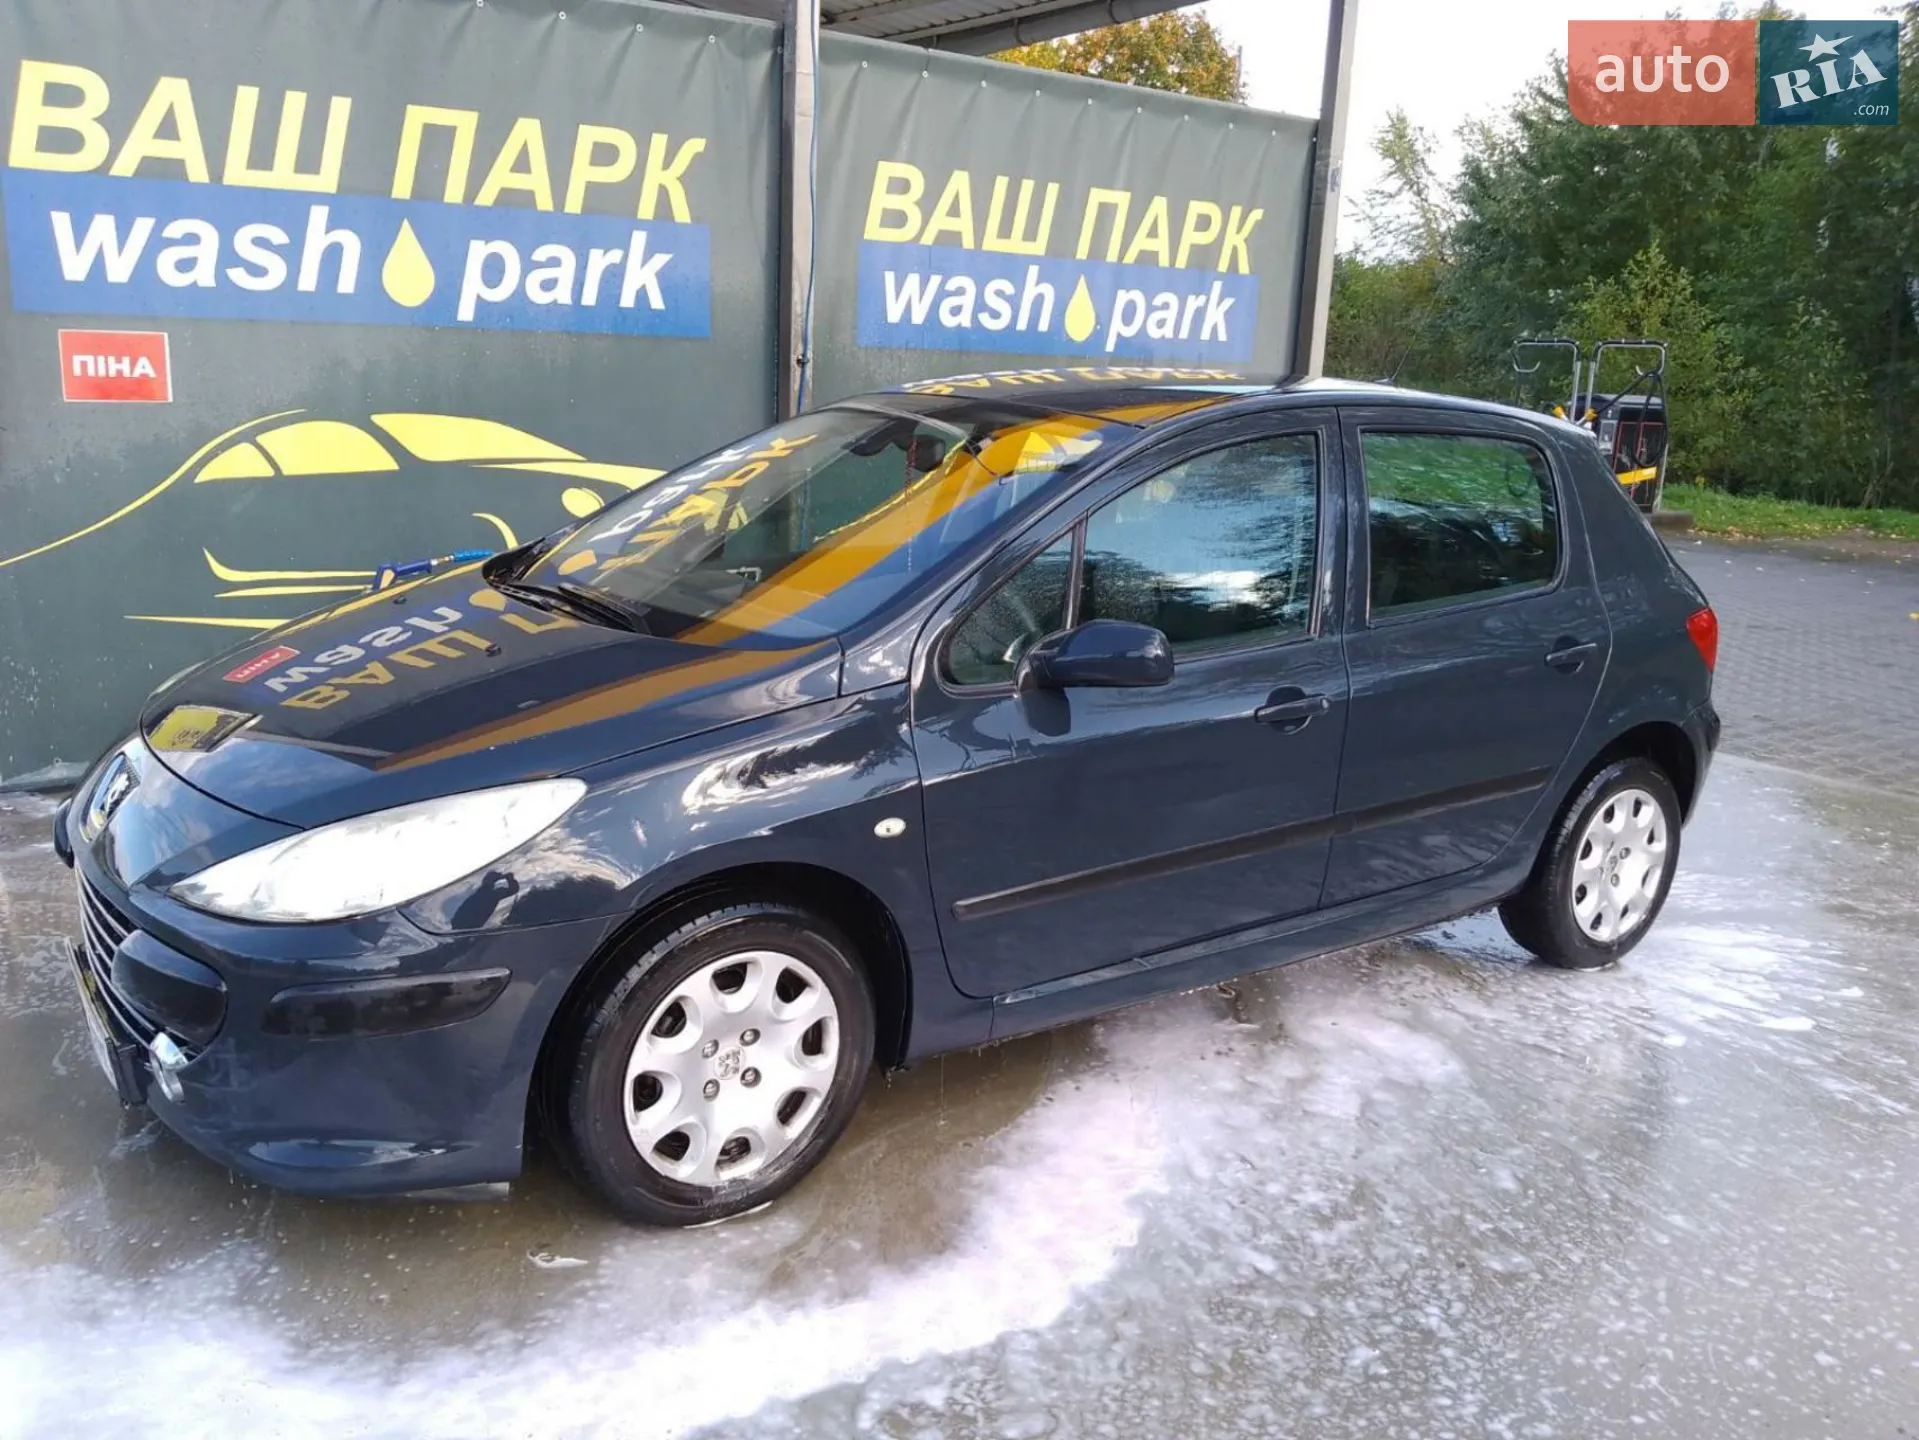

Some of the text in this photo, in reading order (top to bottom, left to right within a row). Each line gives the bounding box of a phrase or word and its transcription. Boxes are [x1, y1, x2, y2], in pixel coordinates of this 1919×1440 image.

[8, 59, 707, 224] ВАШ ПАРК
[50, 205, 673, 322] wash park
[863, 160, 1264, 275] ВАШ ПАРК
[883, 264, 1236, 352] wash park
[71, 353, 157, 380] ПІНА
